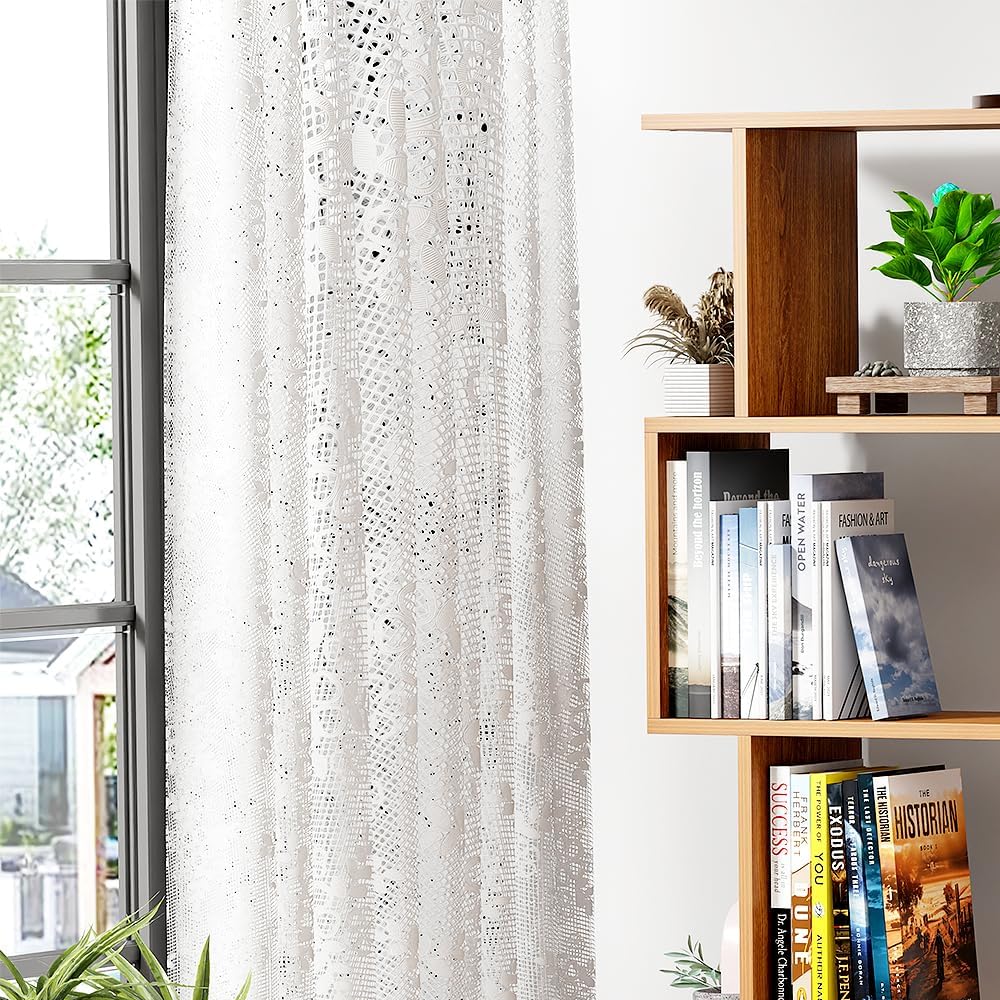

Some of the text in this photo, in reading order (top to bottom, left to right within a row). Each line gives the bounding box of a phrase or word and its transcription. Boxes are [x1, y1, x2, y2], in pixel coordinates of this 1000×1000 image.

[671, 471, 679, 556] Mountains and more
[691, 471, 704, 568] Beyond the horizon
[796, 492, 807, 572] OPEN WATER
[838, 511, 889, 528] FASHION & ART
[876, 786, 891, 843] THE HISTORIAN
[918, 788, 930, 798] THE
[771, 782, 788, 856] SUCCESS
[792, 791, 801, 858] HERBERT
[800, 796, 808, 845] FRANK
[816, 832, 822, 843] OF
[829, 805, 845, 873] EXODUS
[893, 799, 959, 840] HISTORIAN
[814, 852, 824, 886] YOU
[775, 928, 788, 956] Angele
[777, 913, 788, 927] Dr.
